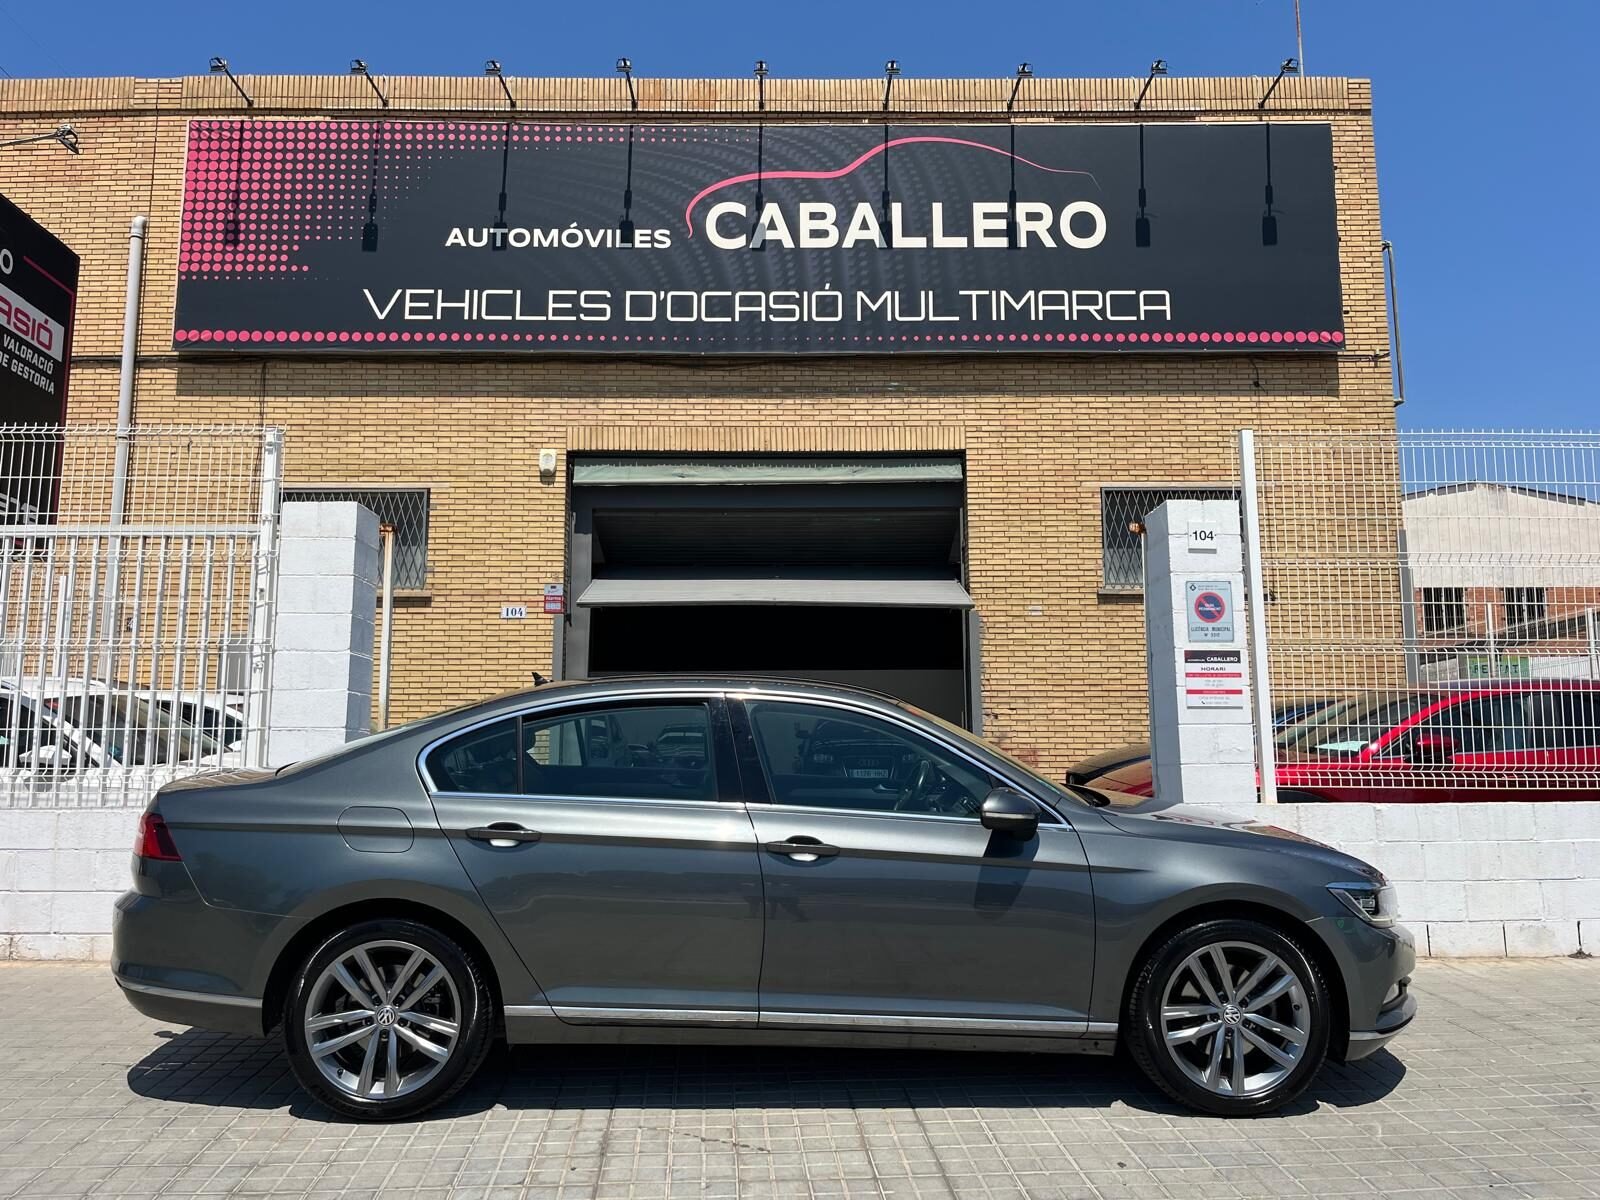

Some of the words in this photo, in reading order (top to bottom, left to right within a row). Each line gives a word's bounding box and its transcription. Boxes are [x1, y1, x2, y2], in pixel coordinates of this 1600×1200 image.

[444, 221, 673, 249] AUTOMÓVILES
[705, 200, 1108, 250] CABALLERO
[362, 288, 613, 322] VEHICLES
[625, 282, 844, 323] D'OCASIÓ
[856, 289, 1172, 322] MULTIMARCA
[3, 333, 54, 375] VALORACIÓ
[10, 358, 55, 395] GESTORIA
[1192, 530, 1215, 541] 104
[505, 607, 524, 616] 104
